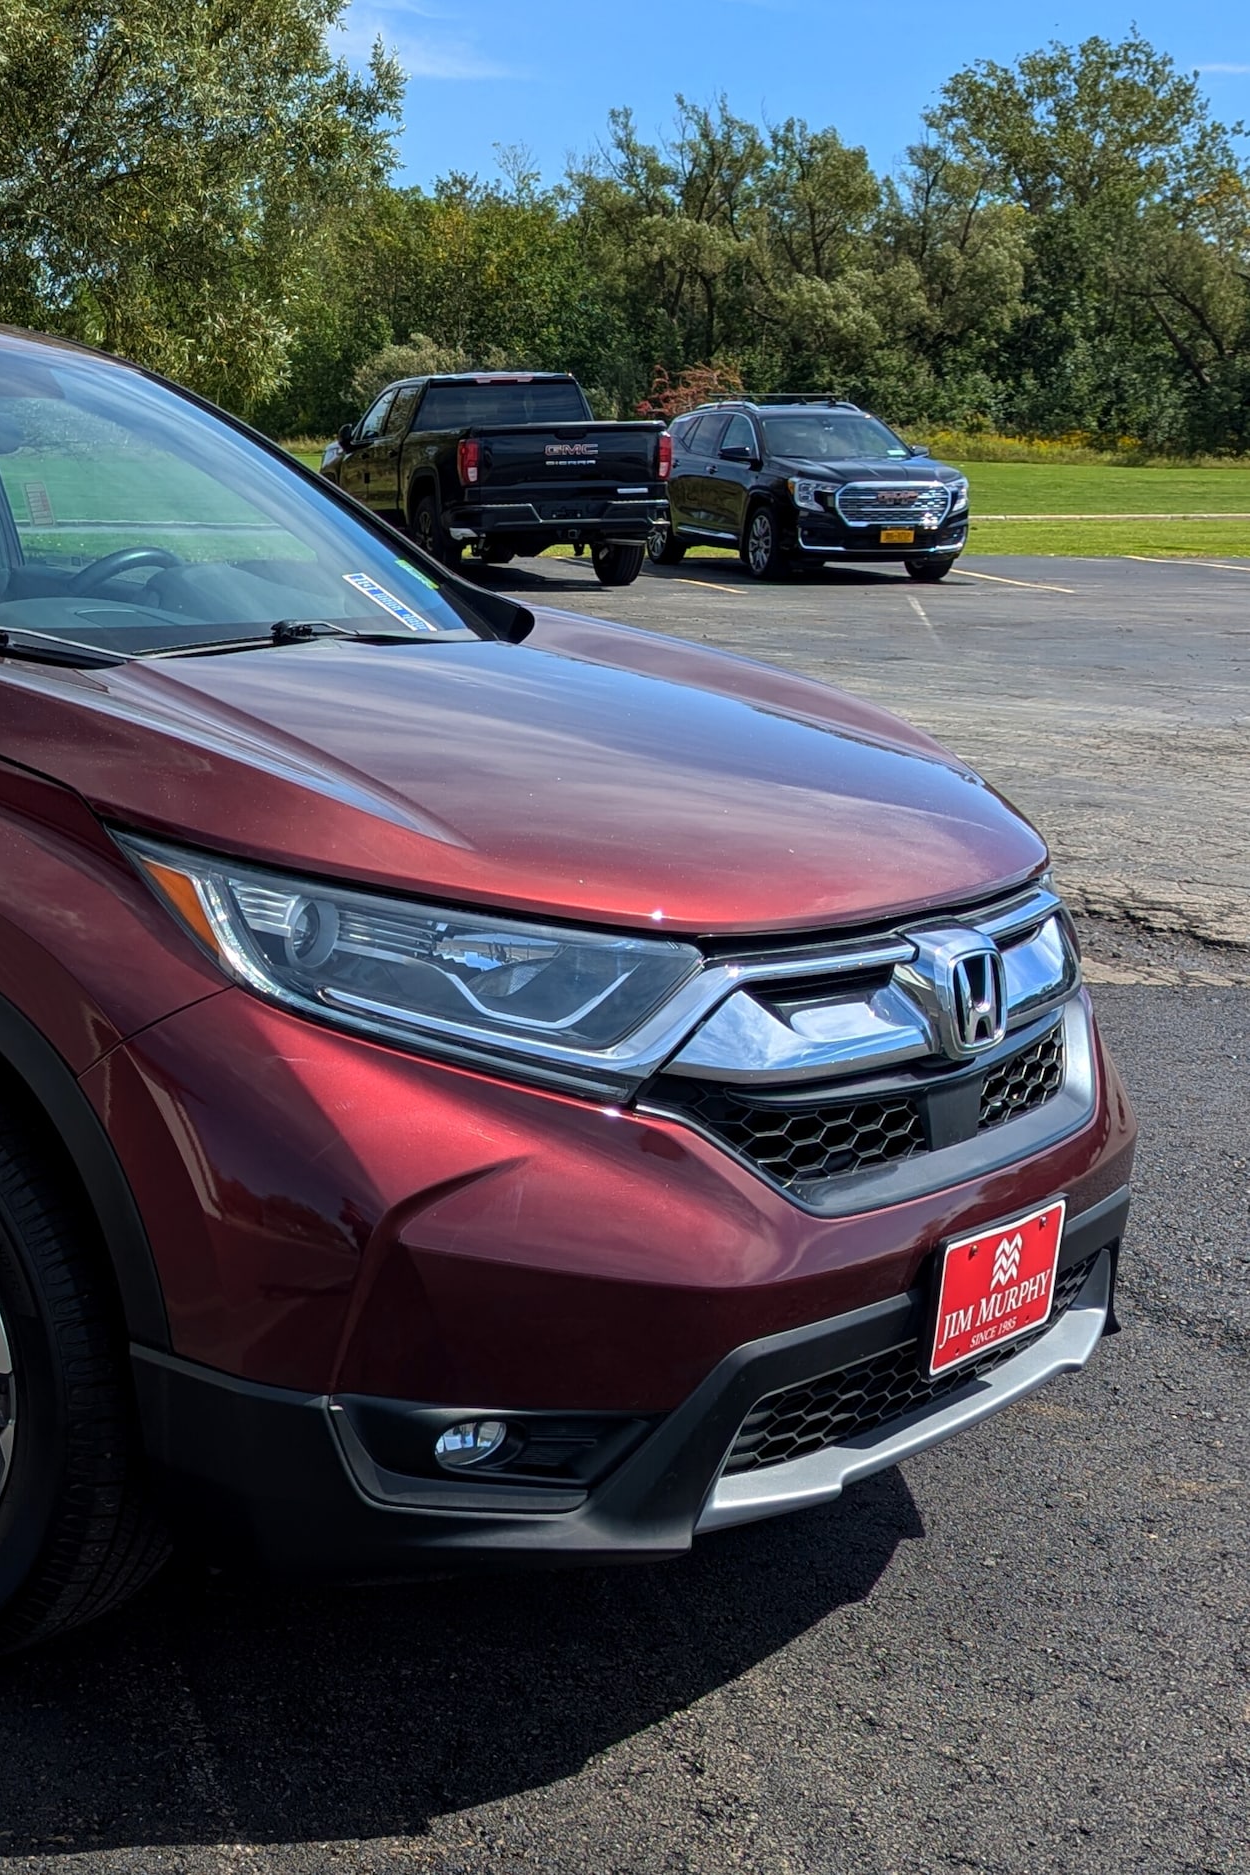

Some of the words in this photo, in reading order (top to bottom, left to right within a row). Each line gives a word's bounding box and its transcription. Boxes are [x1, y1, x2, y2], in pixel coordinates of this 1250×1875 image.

[545, 443, 599, 456] GMC
[938, 1304, 975, 1349] JIM
[976, 1269, 1051, 1327] MURPHY
[970, 1325, 997, 1348] SINCE
[997, 1316, 1018, 1335] 1985
